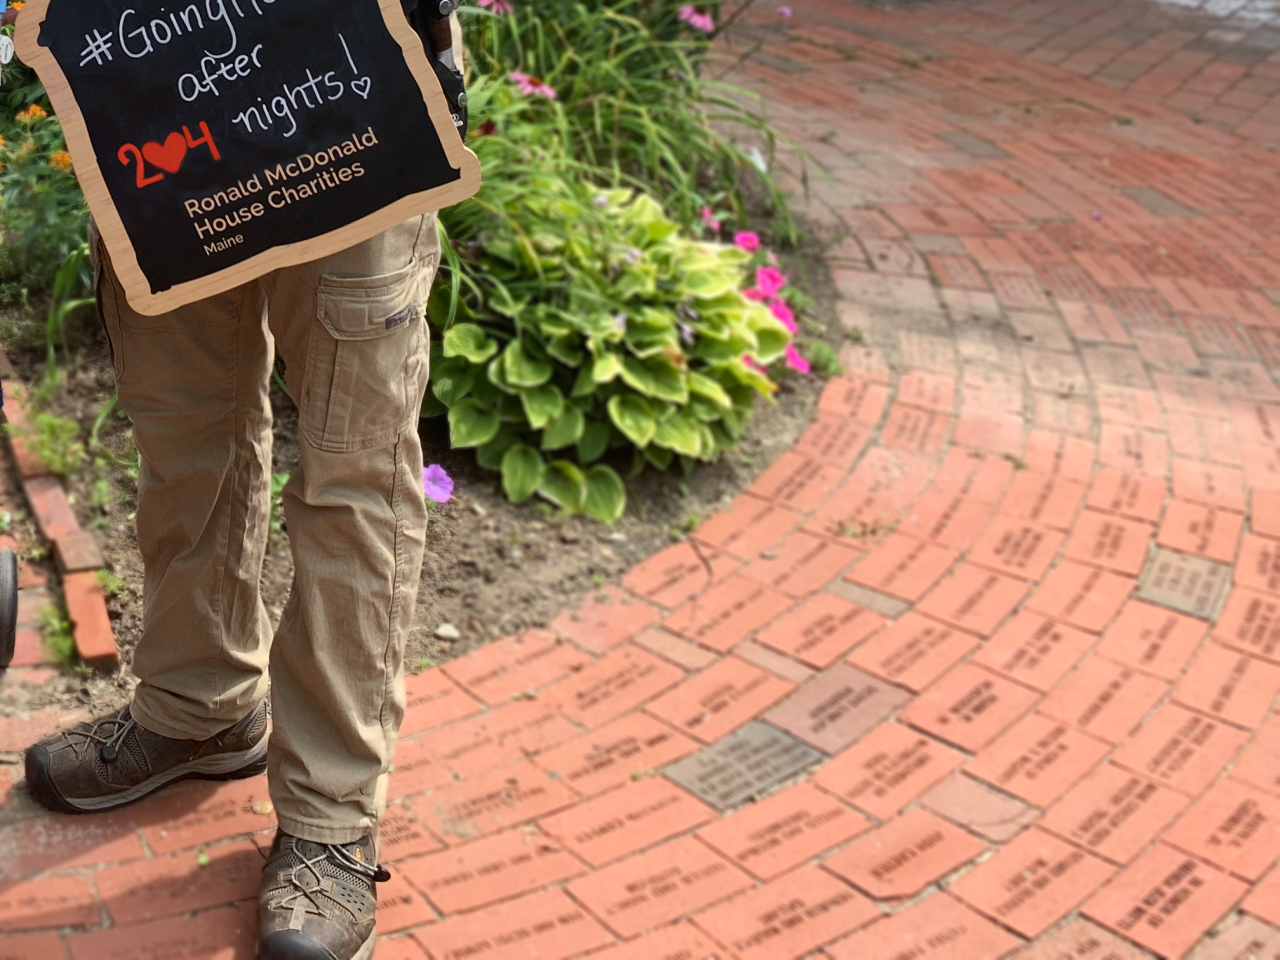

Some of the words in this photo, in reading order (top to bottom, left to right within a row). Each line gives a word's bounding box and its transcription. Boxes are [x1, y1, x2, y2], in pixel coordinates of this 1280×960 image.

[178, 41, 264, 102] after
[232, 33, 372, 137] nights!
[184, 174, 261, 218] Ronald
[263, 126, 379, 185] McDonald
[194, 202, 265, 240] House
[266, 160, 365, 209] Charities
[203, 232, 245, 256] Maine
